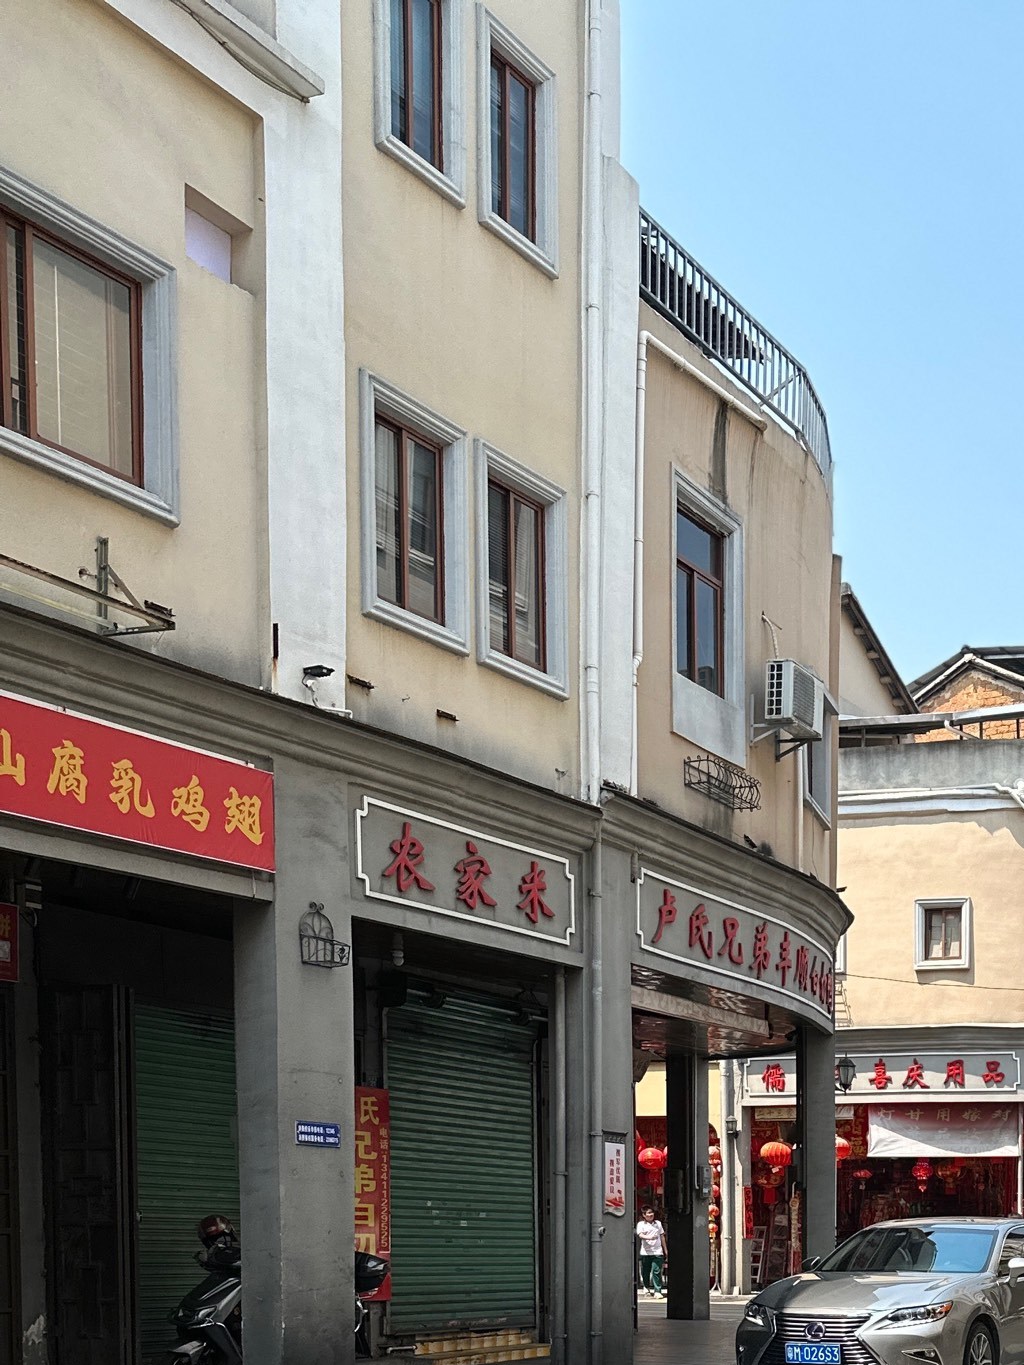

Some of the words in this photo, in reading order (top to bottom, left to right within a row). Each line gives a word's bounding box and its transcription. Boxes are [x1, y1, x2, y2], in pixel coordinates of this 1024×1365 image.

[382, 821, 556, 924] 农家米
[761, 1058, 1005, 1092] 儒喜庆用品
